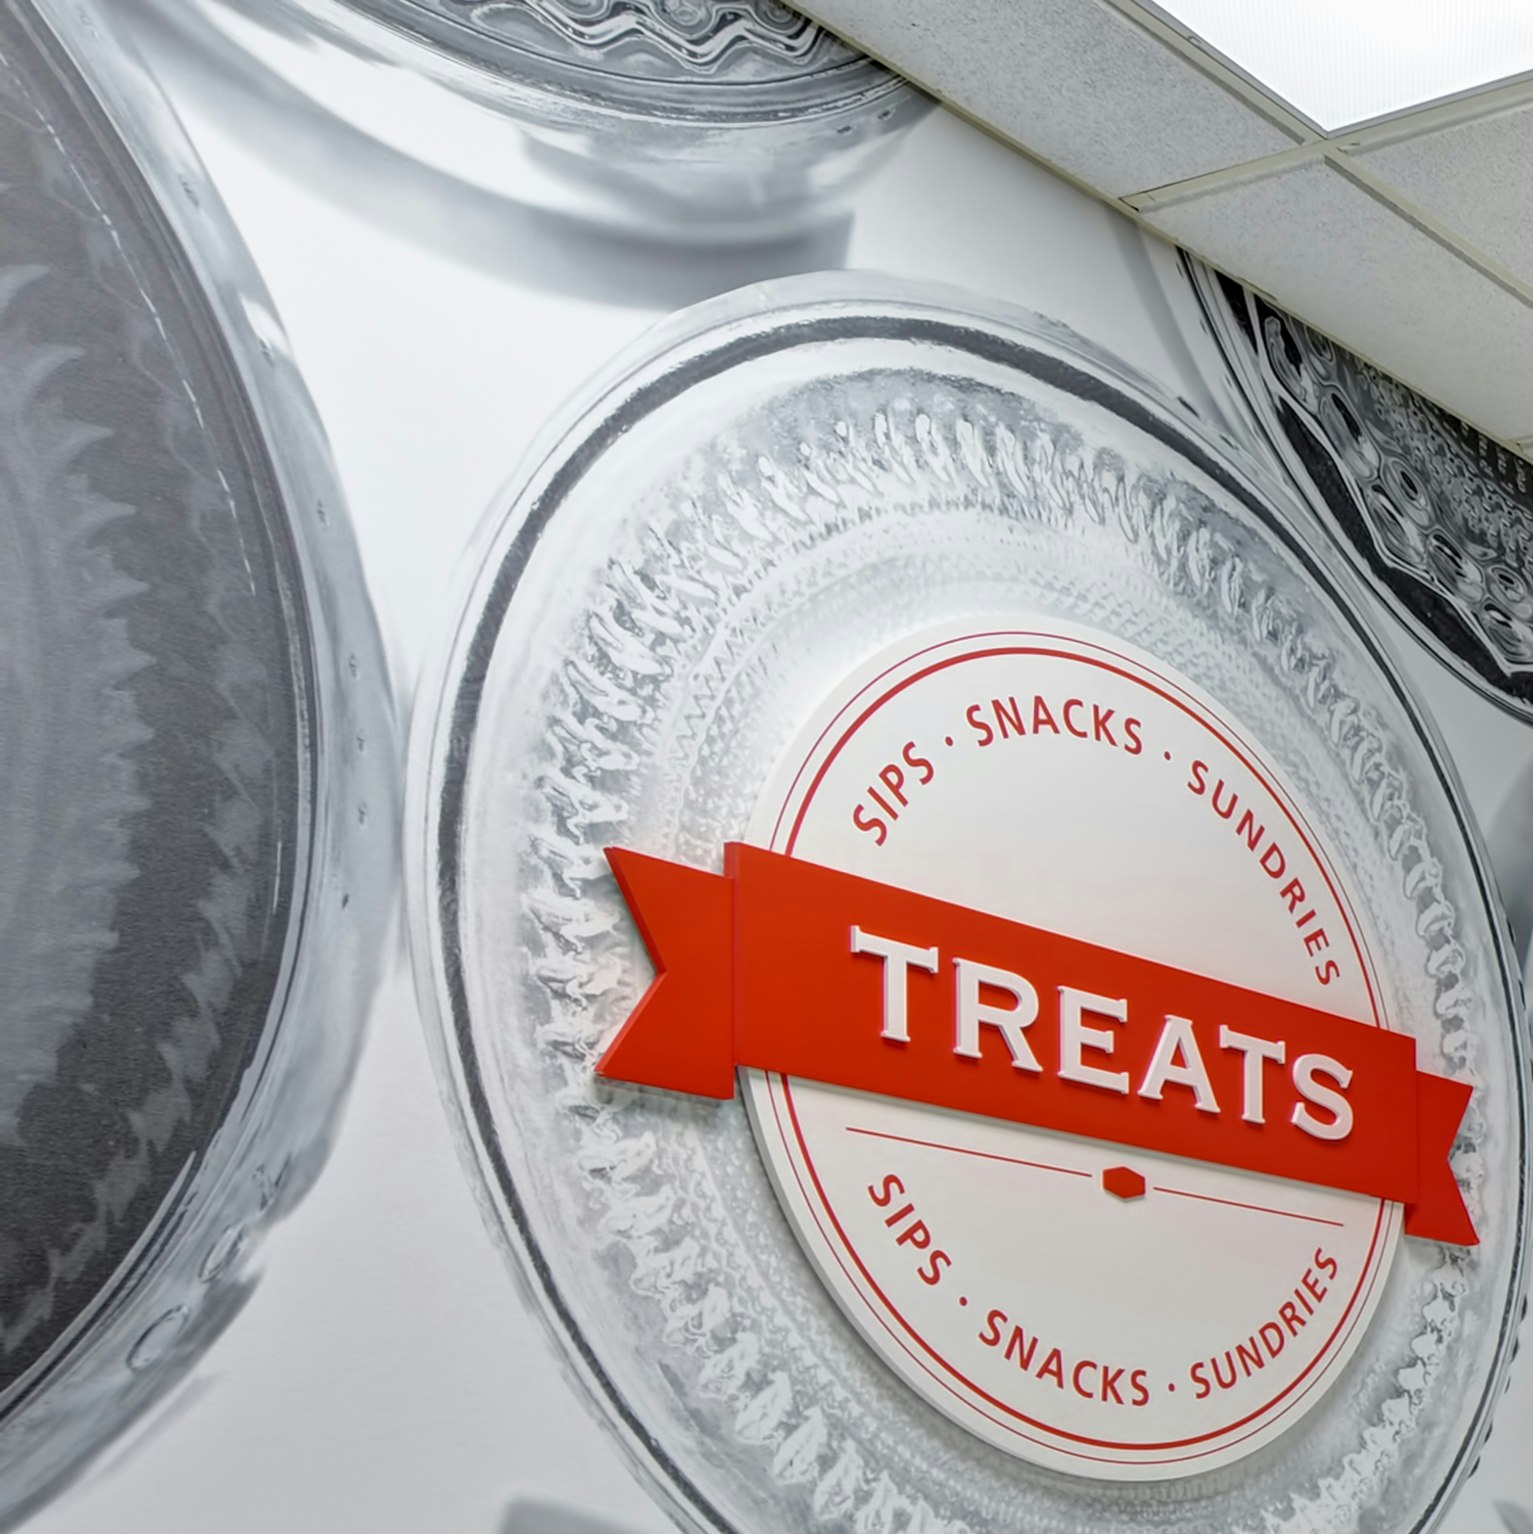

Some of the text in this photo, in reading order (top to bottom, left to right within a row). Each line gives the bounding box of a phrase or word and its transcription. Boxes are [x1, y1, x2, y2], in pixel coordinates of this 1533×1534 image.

[851, 694, 1341, 987] SIPS SNACKS SUNDRIES
[849, 924, 1355, 1141] TREATS
[868, 1173, 1341, 1407] SIPS SNACKS SUNDRIES
